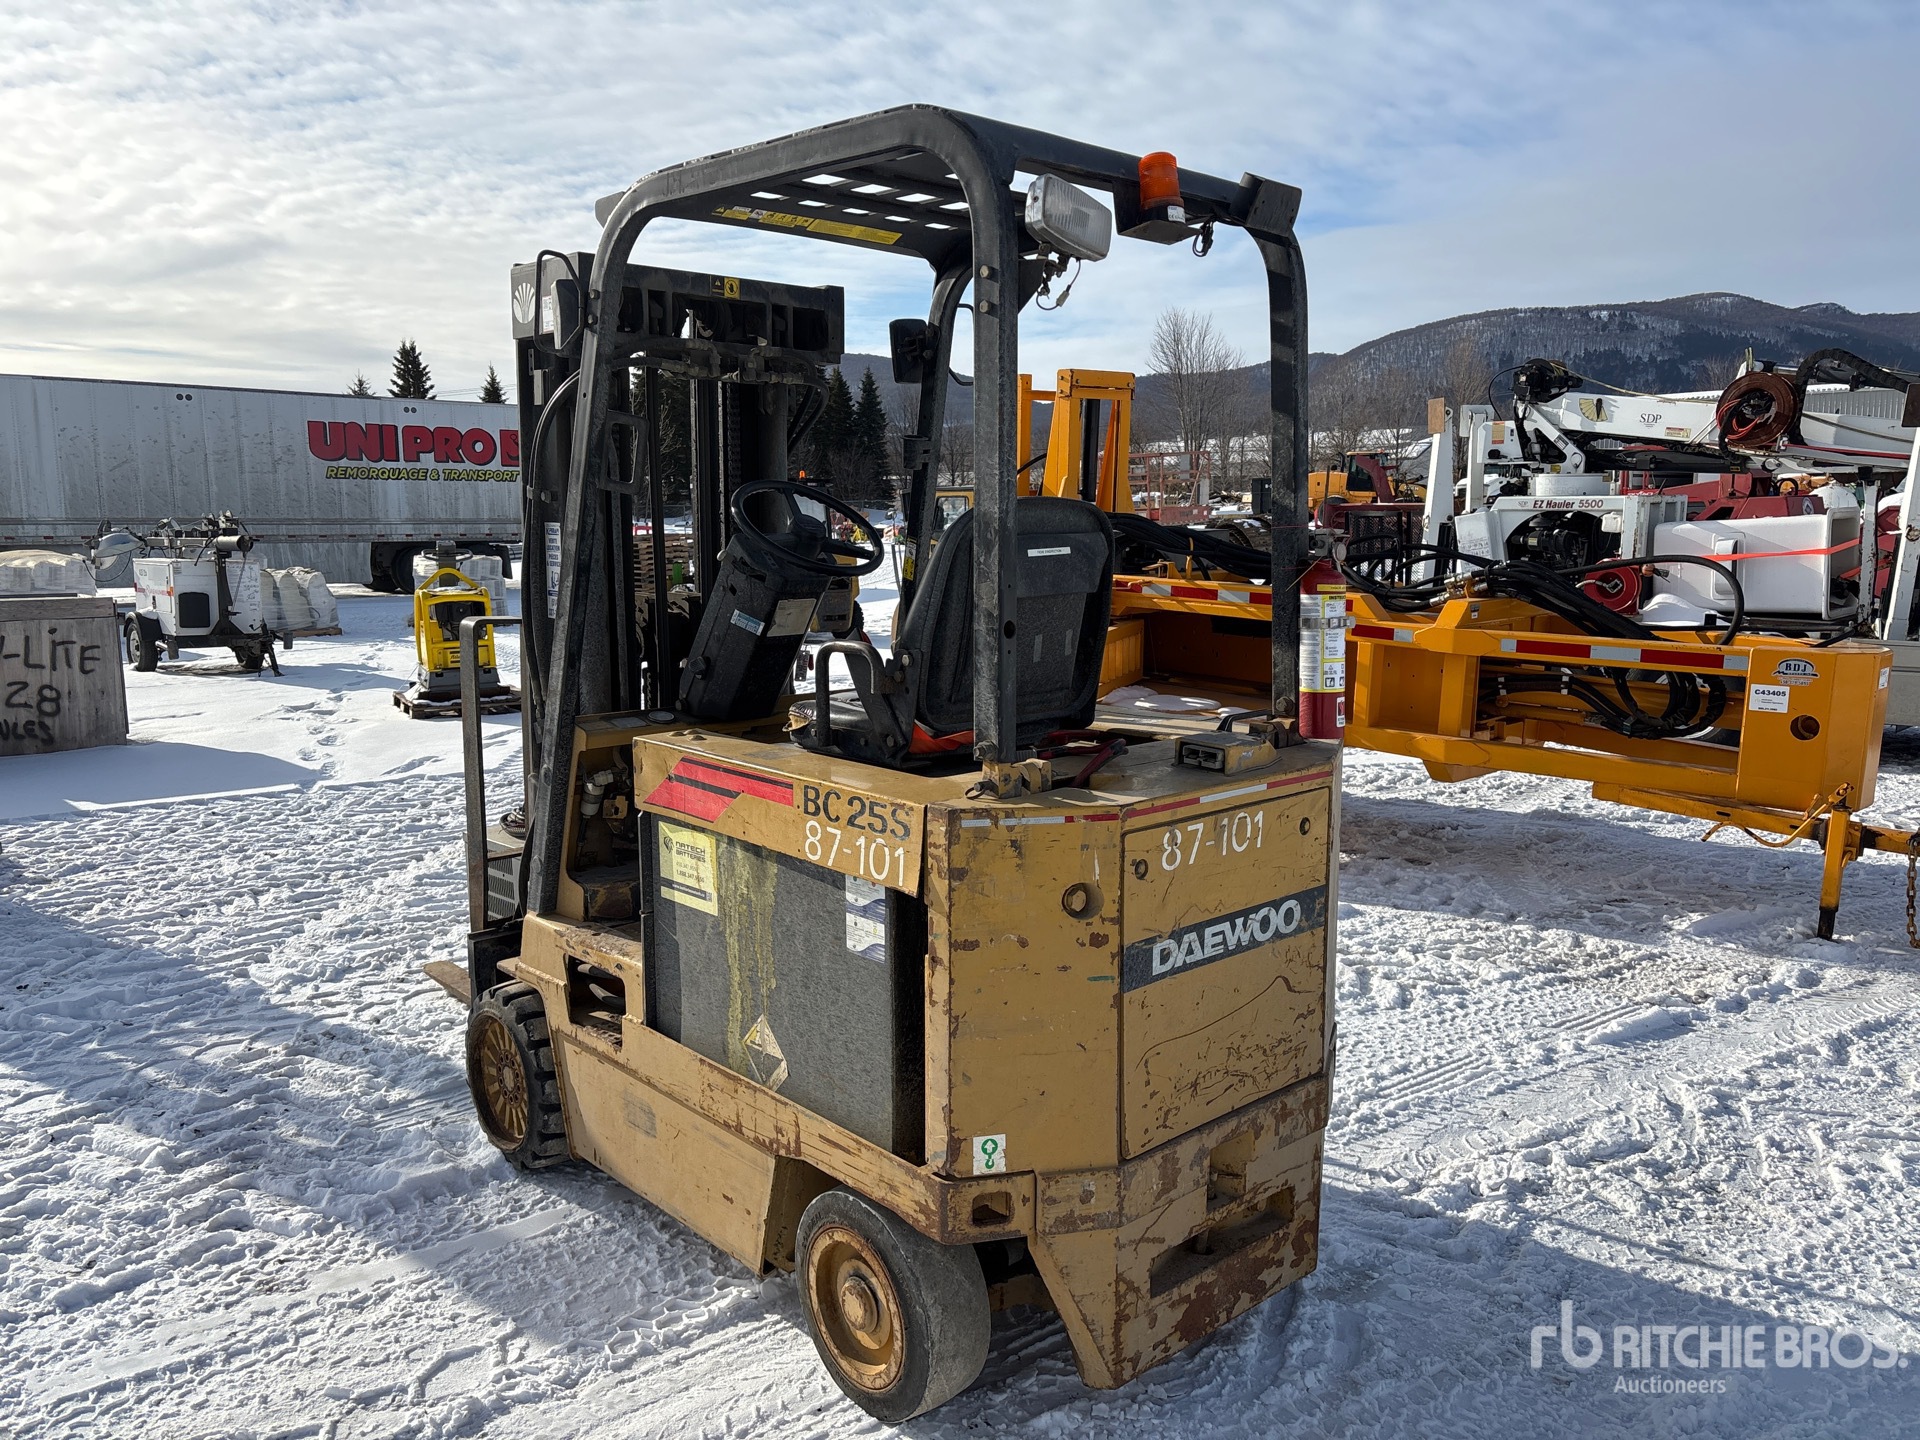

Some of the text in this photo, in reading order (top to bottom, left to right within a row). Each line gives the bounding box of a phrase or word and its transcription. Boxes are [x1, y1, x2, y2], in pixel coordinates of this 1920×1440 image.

[1639, 413, 1662, 424] SDP
[307, 421, 497, 466] UNI PRO
[326, 466, 520, 482] REMORQUAGE & TRANSPORT
[1532, 500, 1545, 509] EZ
[1546, 500, 1575, 509] Hauler
[1578, 499, 1604, 509] 5500
[1785, 663, 1808, 672] RDJ
[1754, 688, 1787, 697] C43405
[675, 841, 706, 855] NATECH
[1161, 811, 1264, 871] 87-101
[675, 849, 706, 863] BATTERIES
[804, 820, 905, 887] 87-101
[1152, 899, 1301, 976] DAEWOO
